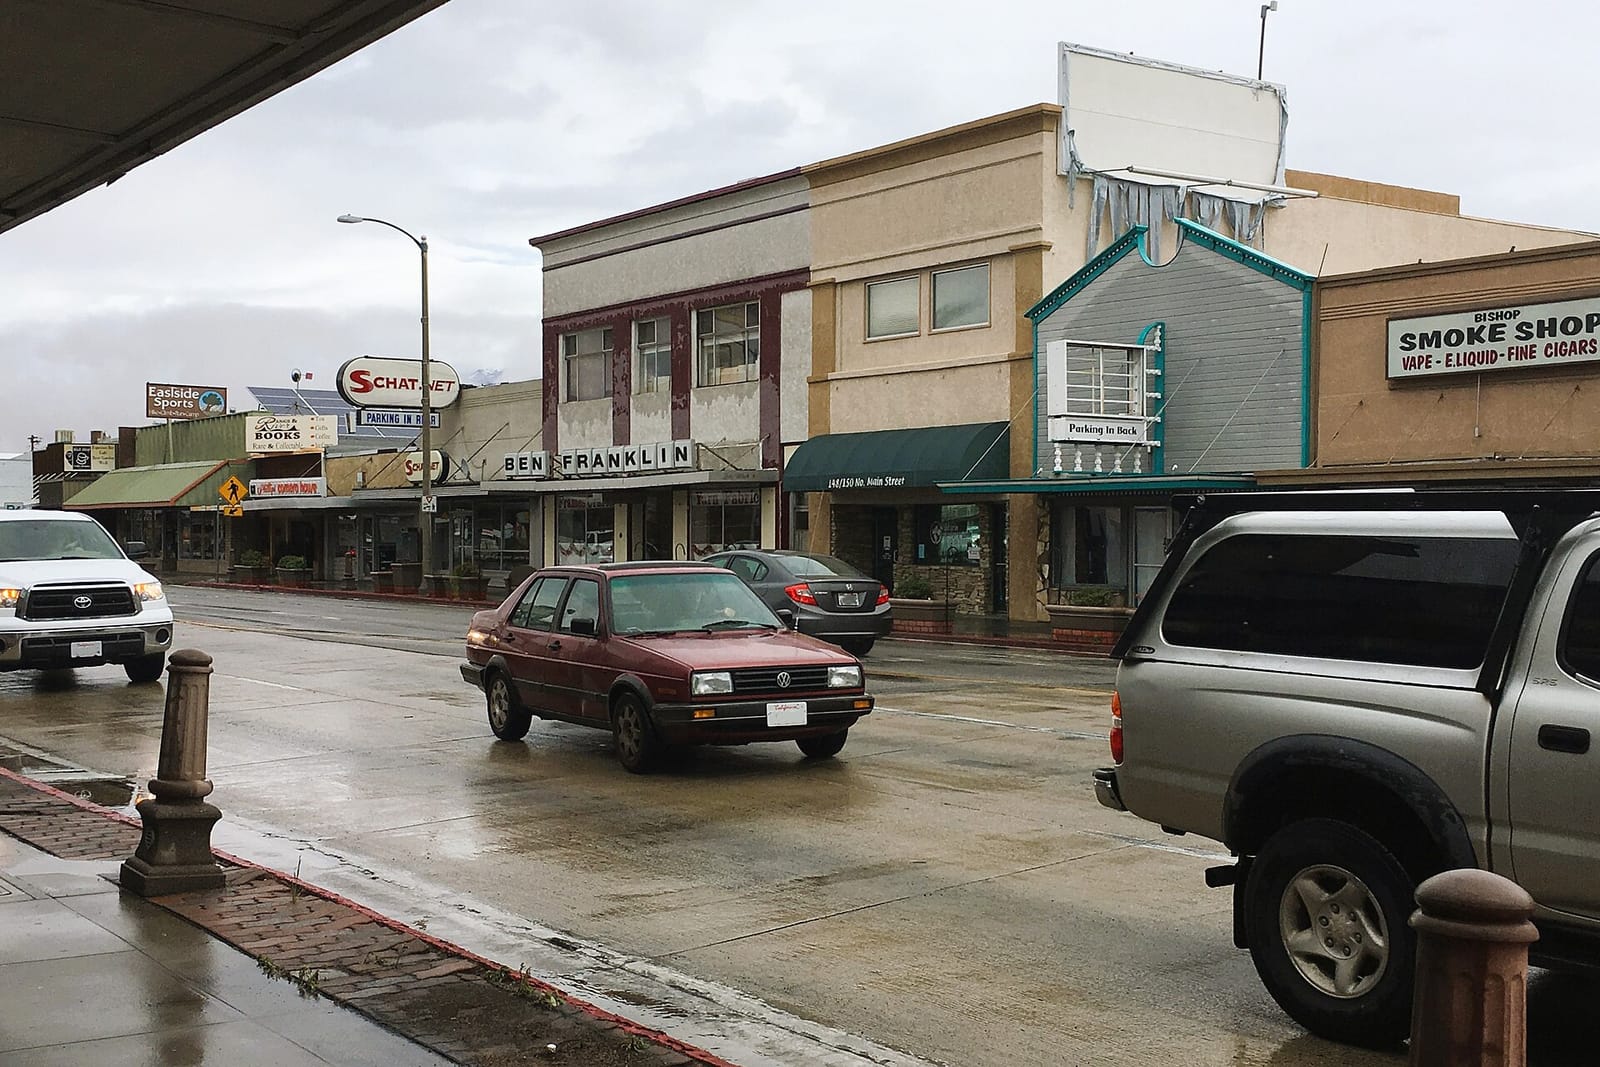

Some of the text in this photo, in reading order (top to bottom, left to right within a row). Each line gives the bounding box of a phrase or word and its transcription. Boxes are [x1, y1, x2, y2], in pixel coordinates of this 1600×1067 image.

[1474, 309, 1521, 323] BISHOP
[1399, 313, 1600, 352] SMOKE SHOP
[1402, 354, 1432, 371] VAPE
[1507, 343, 1537, 361] FINE
[1543, 338, 1598, 358] CIGARS
[148, 386, 200, 399] Eastside
[153, 397, 194, 410] Sports
[366, 412, 436, 425] PARKING IN RR
[255, 432, 301, 440] BOOKS
[1069, 423, 1138, 436] Parking In Back
[504, 446, 688, 472] BEN FRANKLIN
[828, 475, 906, 489] 148/150 No. Main Street
